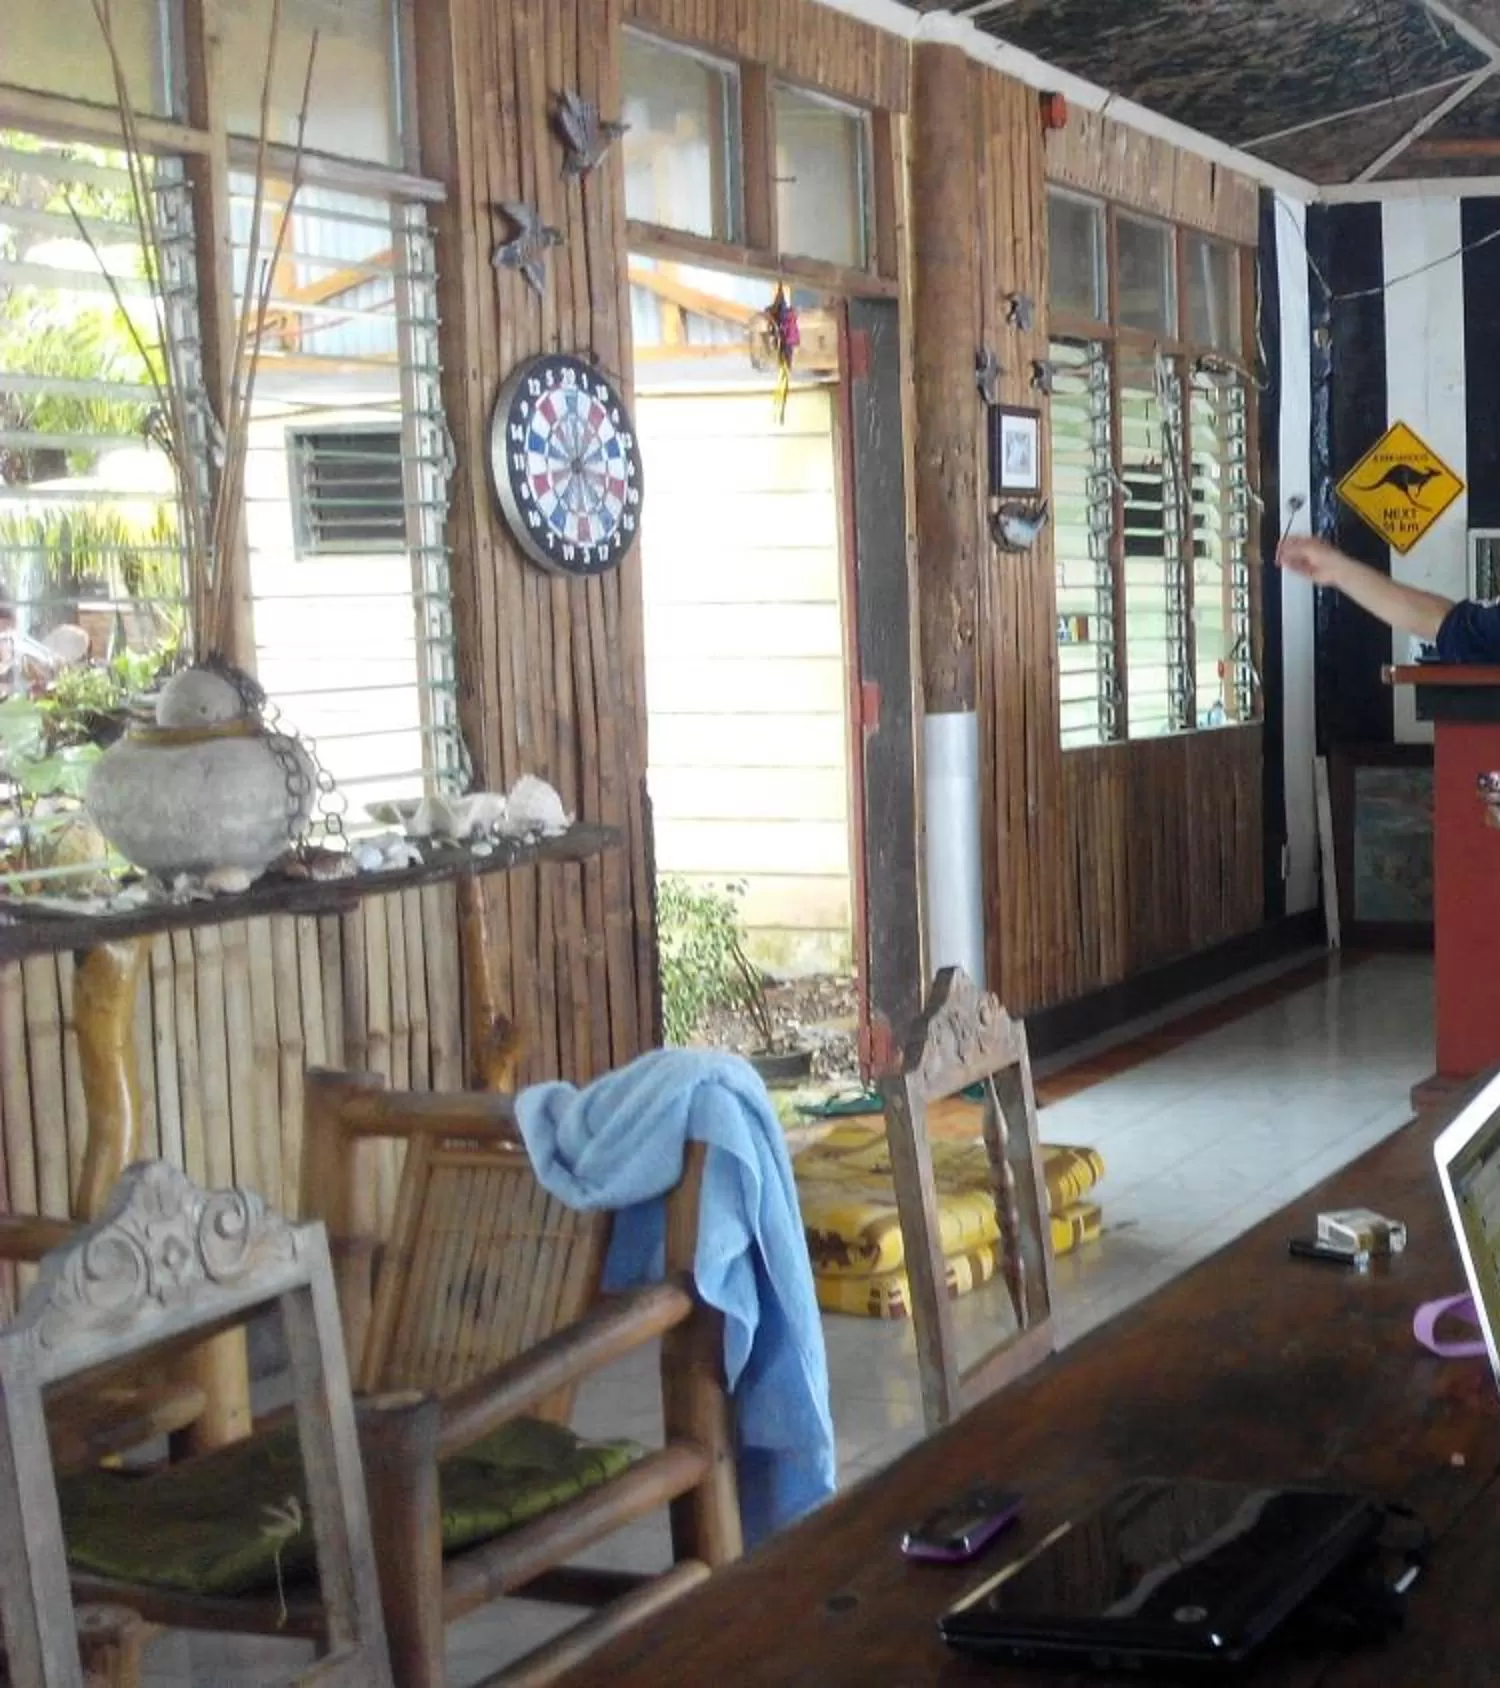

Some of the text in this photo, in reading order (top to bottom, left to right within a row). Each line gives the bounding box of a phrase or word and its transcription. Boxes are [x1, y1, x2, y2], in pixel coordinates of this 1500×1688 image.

[560, 367, 576, 388] 20
[581, 372, 589, 390] 1
[513, 453, 525, 471] 11
[1383, 507, 1417, 520] NEXT
[1400, 520, 1420, 533] km
